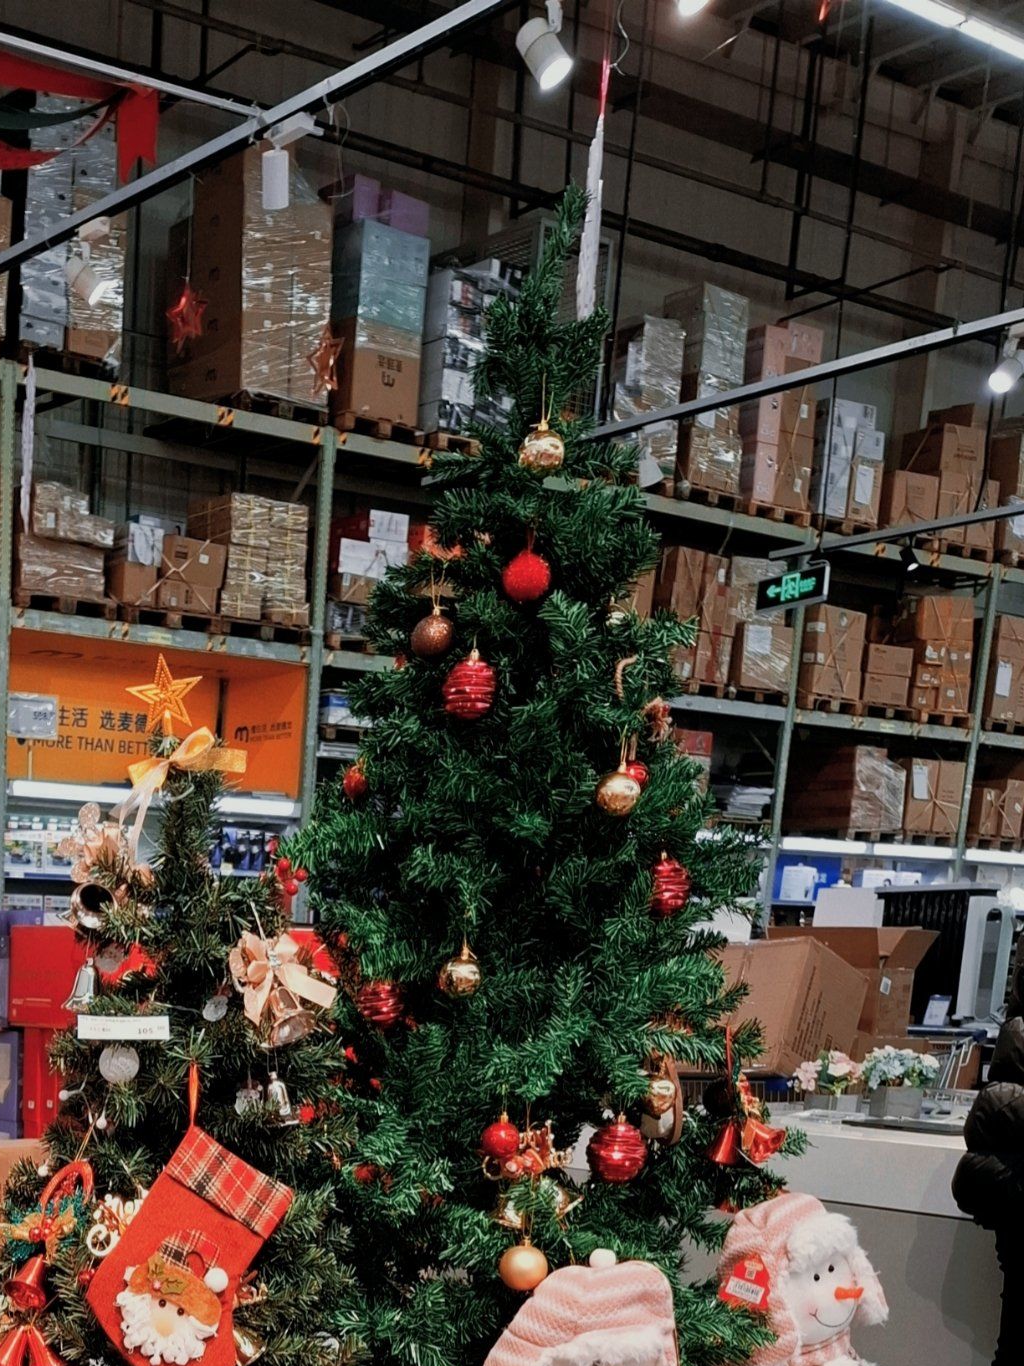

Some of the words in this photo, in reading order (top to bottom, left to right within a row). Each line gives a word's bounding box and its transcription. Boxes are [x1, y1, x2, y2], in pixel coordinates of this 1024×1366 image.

[58, 705, 89, 728] 生活
[99, 711, 163, 735] 选麦德
[77, 737, 114, 753] THAN
[118, 742, 156, 756] BETT
